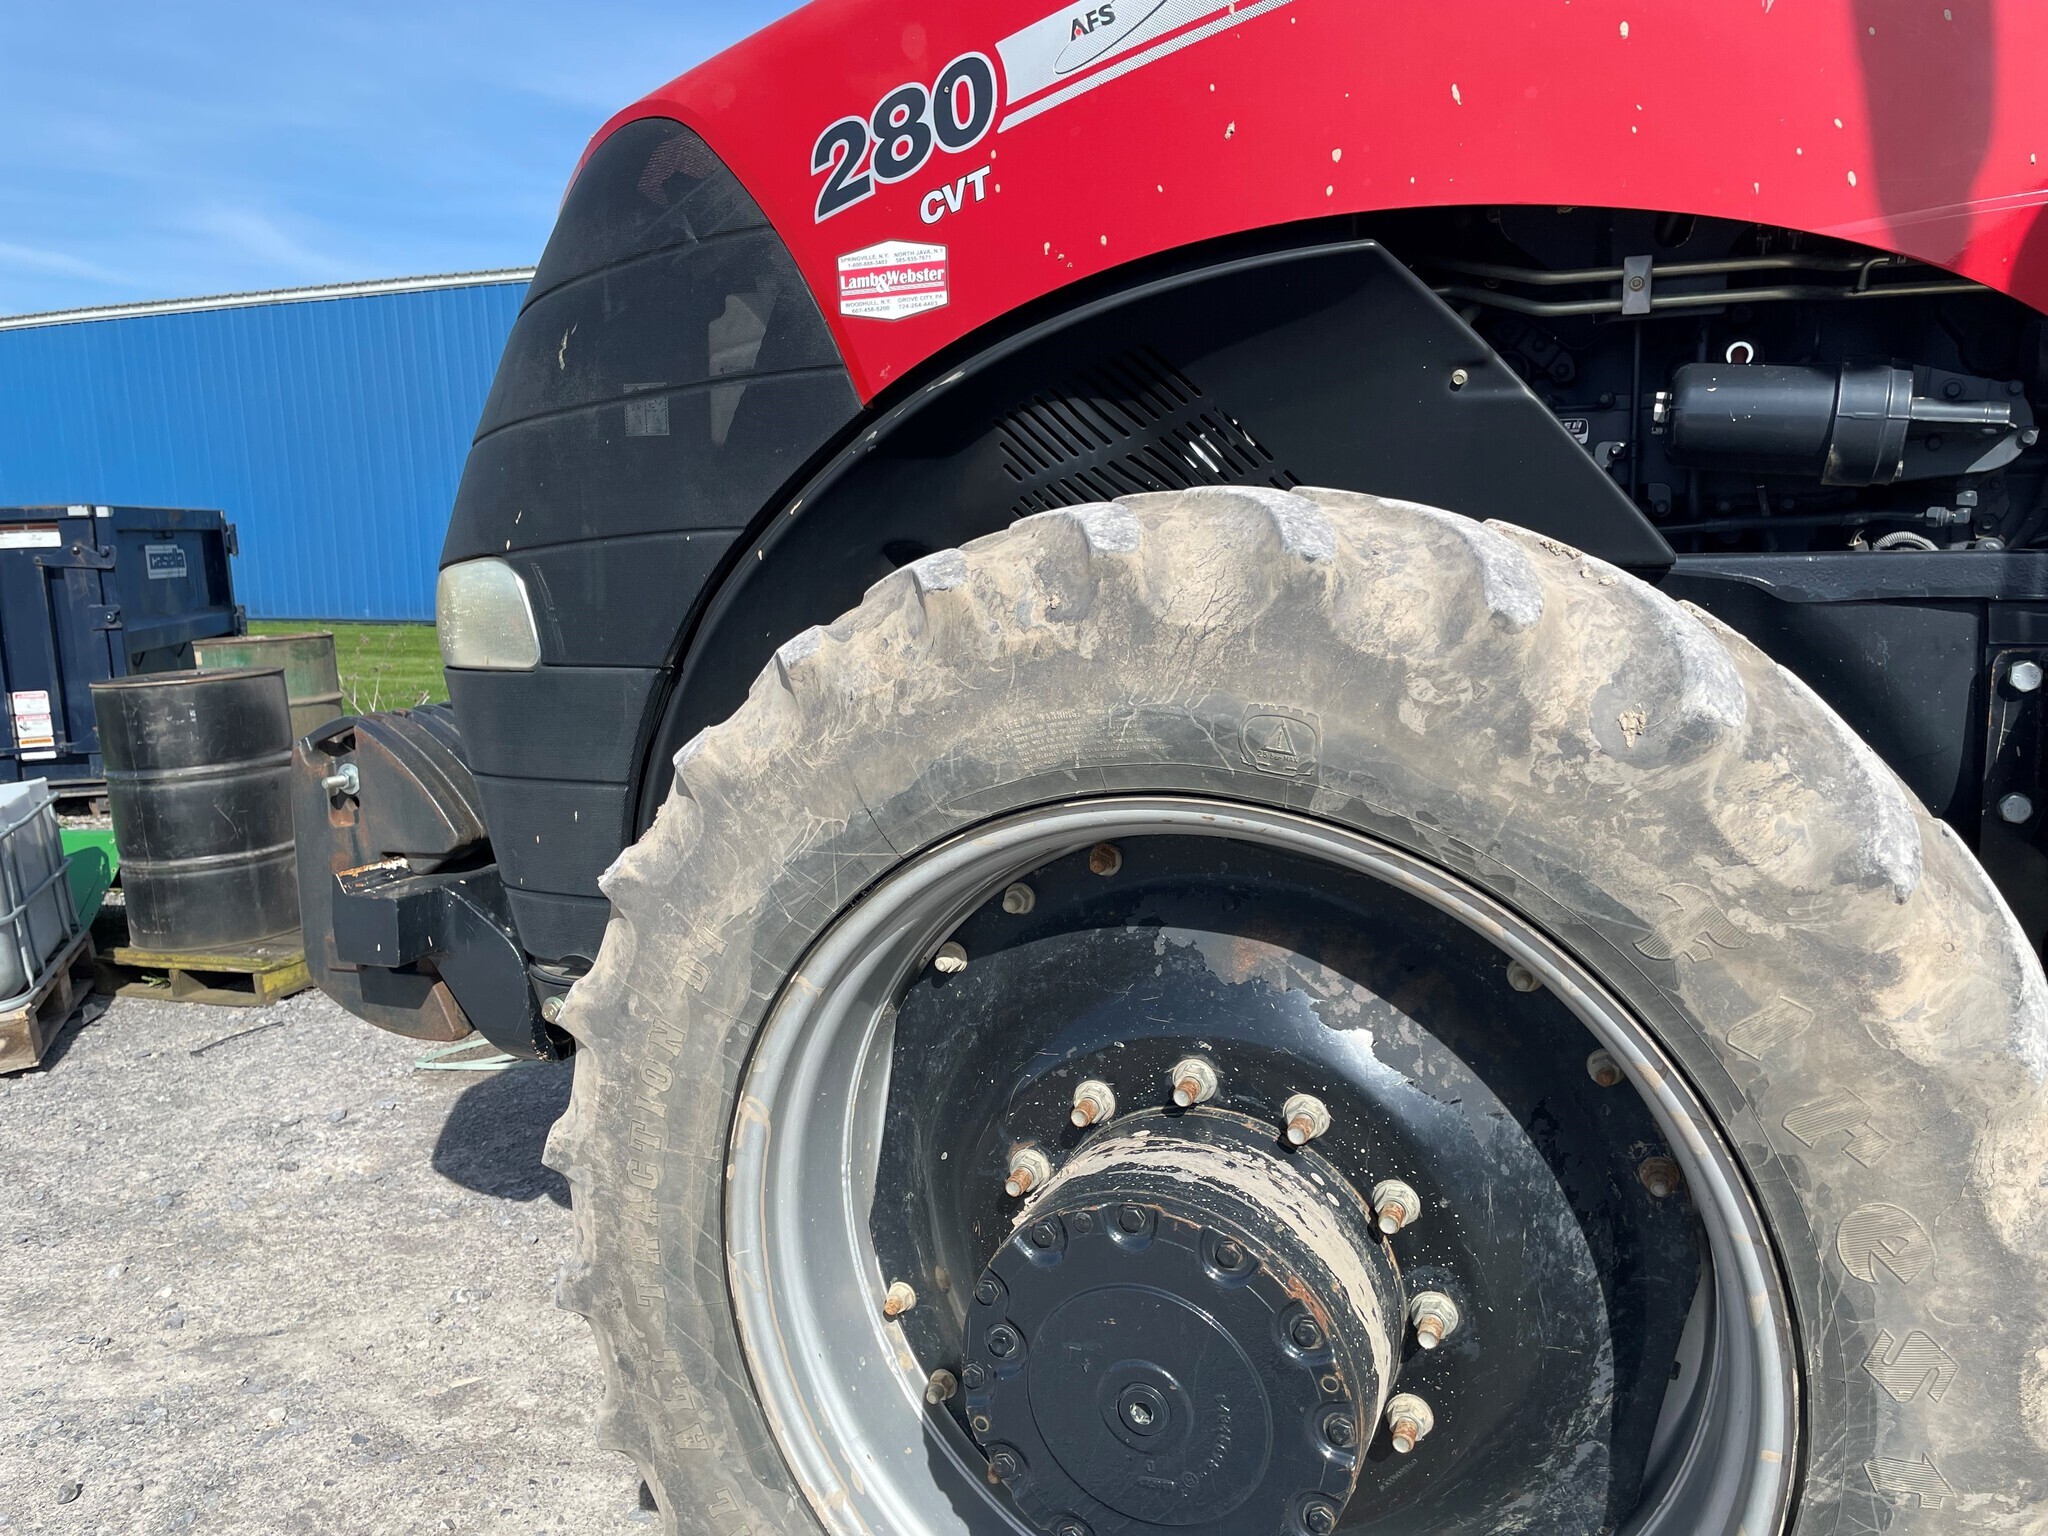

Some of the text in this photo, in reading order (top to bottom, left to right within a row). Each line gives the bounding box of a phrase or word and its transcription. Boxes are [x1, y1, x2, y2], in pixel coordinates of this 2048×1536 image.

[1070, 3, 1116, 42] AFS
[810, 51, 998, 225] 280
[919, 164, 992, 225] CVT
[625, 914, 729, 1450] ALL TRACTION DT
